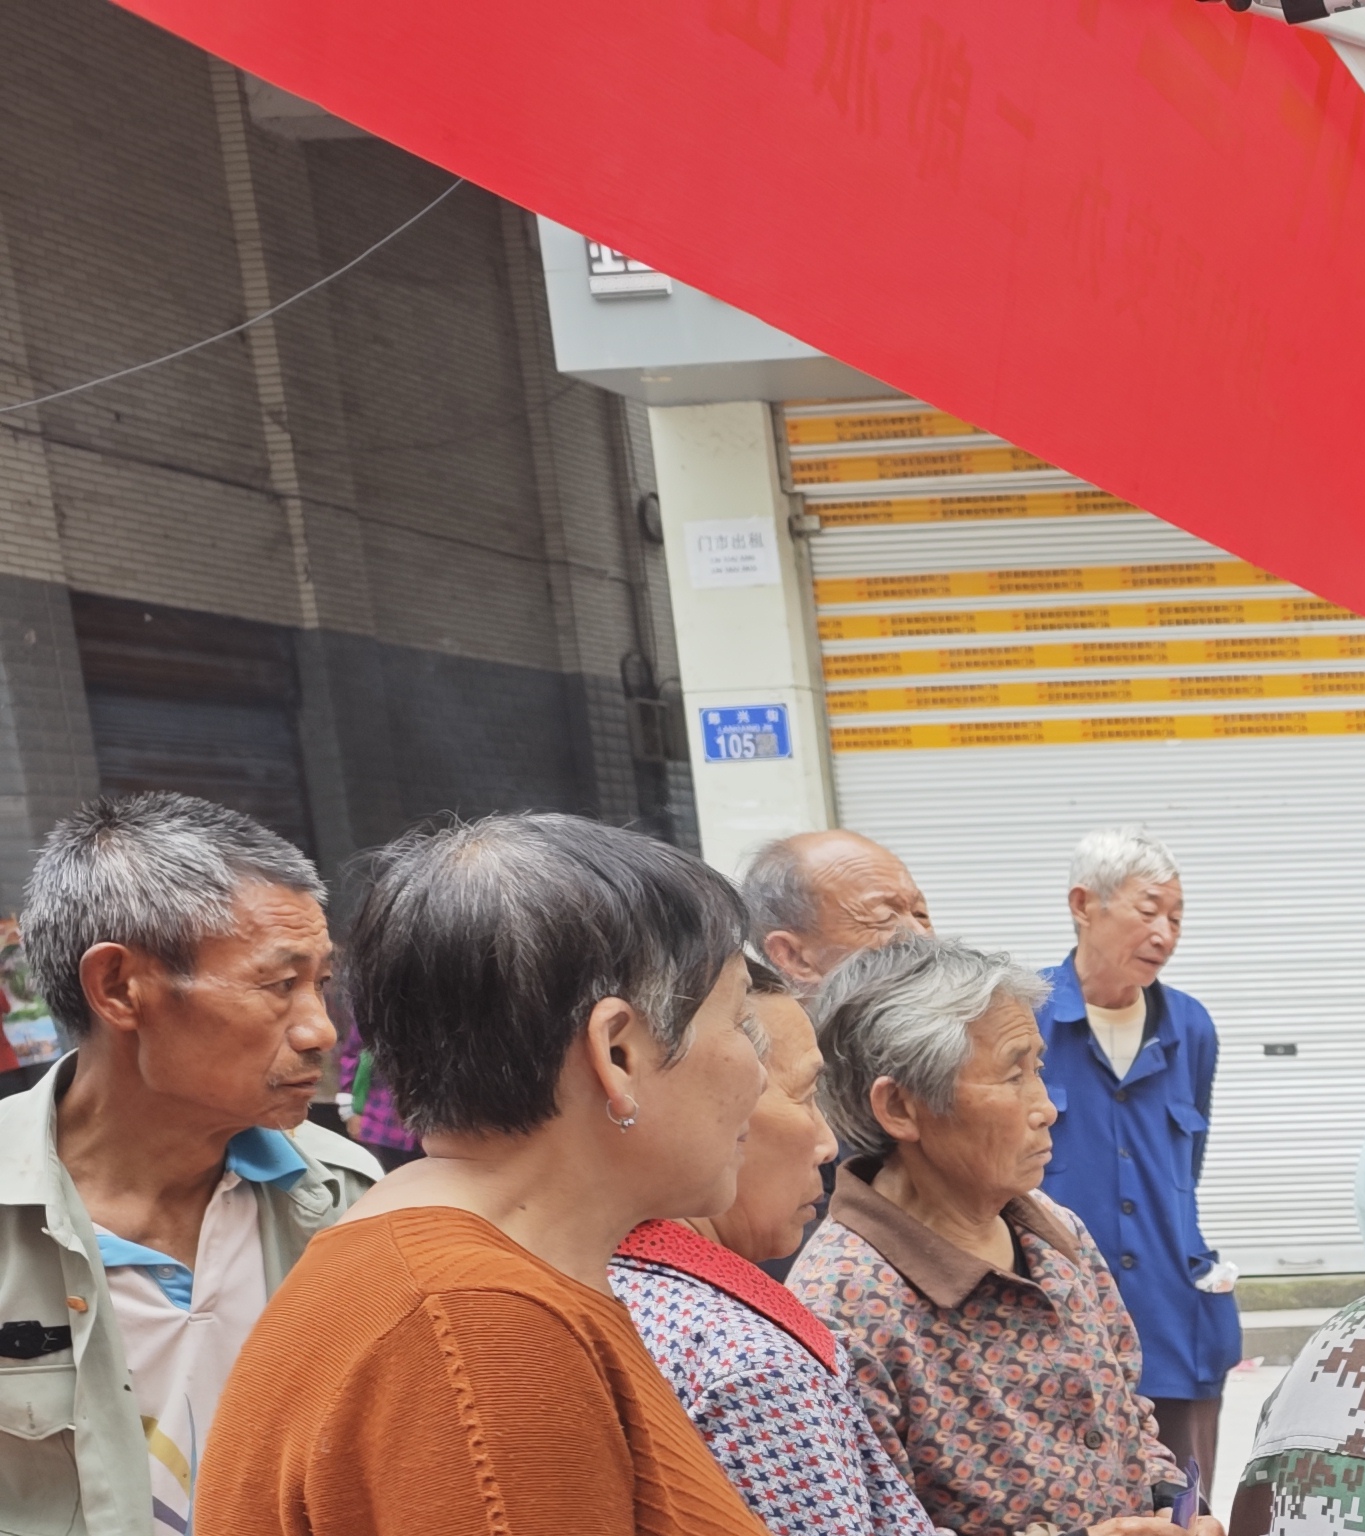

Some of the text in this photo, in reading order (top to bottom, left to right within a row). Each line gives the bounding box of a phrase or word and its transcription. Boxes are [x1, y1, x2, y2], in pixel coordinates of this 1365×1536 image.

[698, 532, 764, 551] 门市出租
[715, 733, 756, 759] 105
